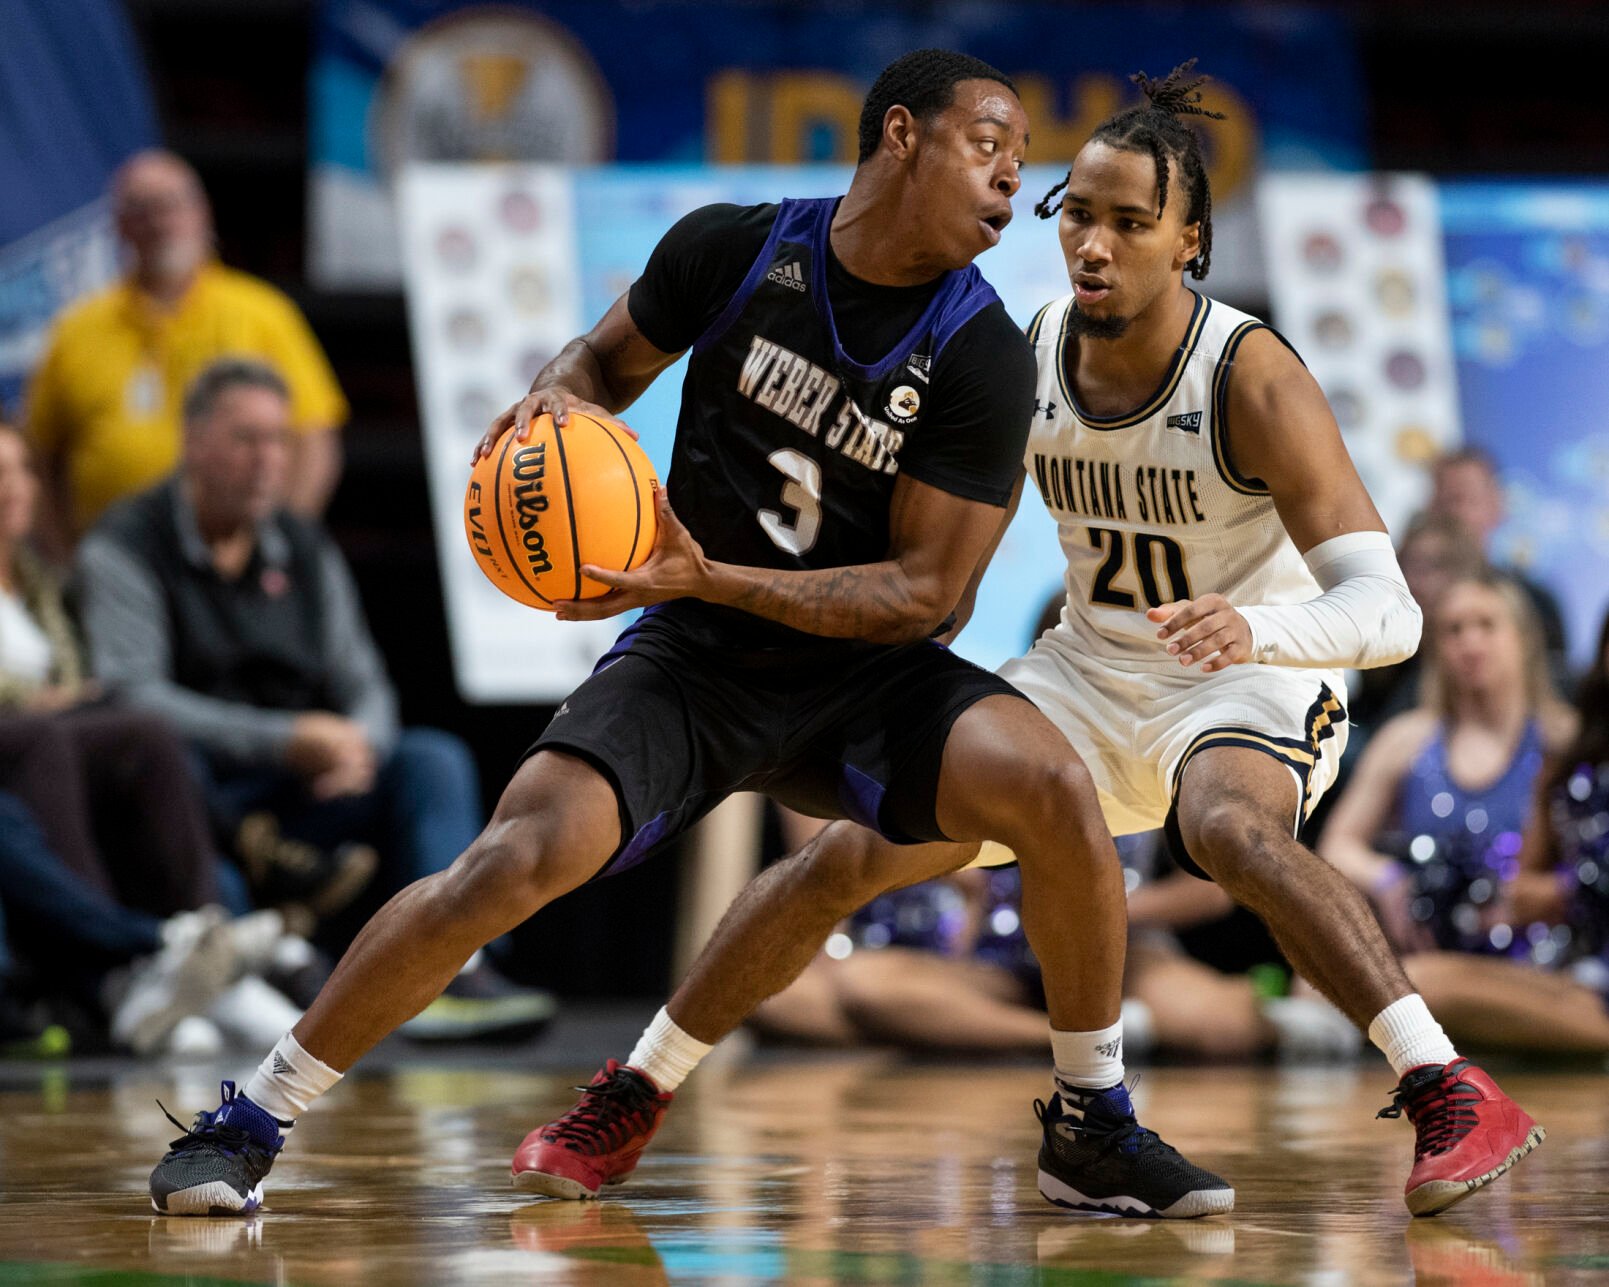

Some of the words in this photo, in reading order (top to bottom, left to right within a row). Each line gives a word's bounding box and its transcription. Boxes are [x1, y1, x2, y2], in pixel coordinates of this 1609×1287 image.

[709, 70, 1257, 200] IDHO
[767, 272, 806, 292] adidas
[737, 335, 840, 438] WEBER
[825, 396, 904, 476] STATE
[884, 406, 898, 422] United
[906, 416, 918, 424] One
[512, 441, 553, 576] Wilson
[757, 447, 822, 556] 3
[1034, 453, 1127, 520] MONTANA
[1136, 465, 1205, 525] STATE
[1085, 527, 1194, 611] 20
